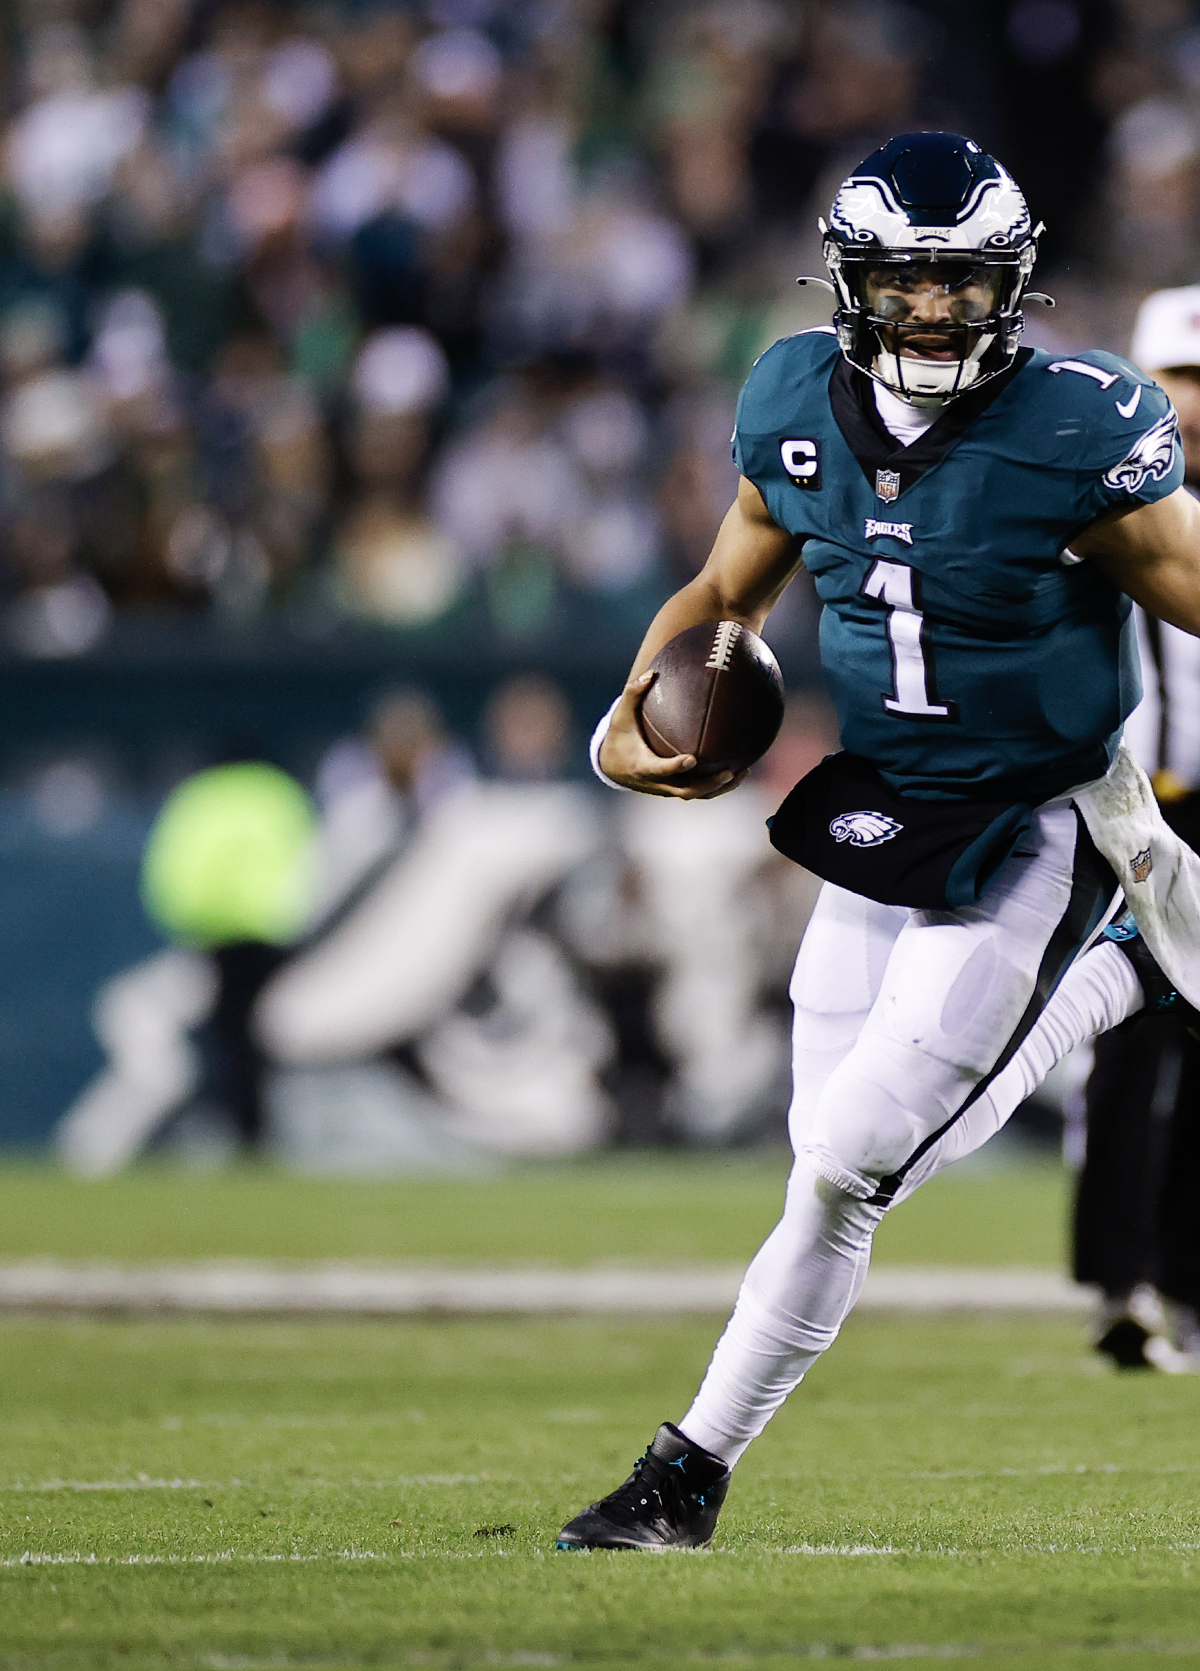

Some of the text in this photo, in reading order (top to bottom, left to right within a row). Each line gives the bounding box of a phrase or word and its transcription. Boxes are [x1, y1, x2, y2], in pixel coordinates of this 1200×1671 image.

[1046, 359, 1121, 391] 1
[780, 439, 818, 477] C
[880, 482, 897, 496] NFL
[864, 518, 914, 545] EAGLES
[861, 556, 956, 720] 1
